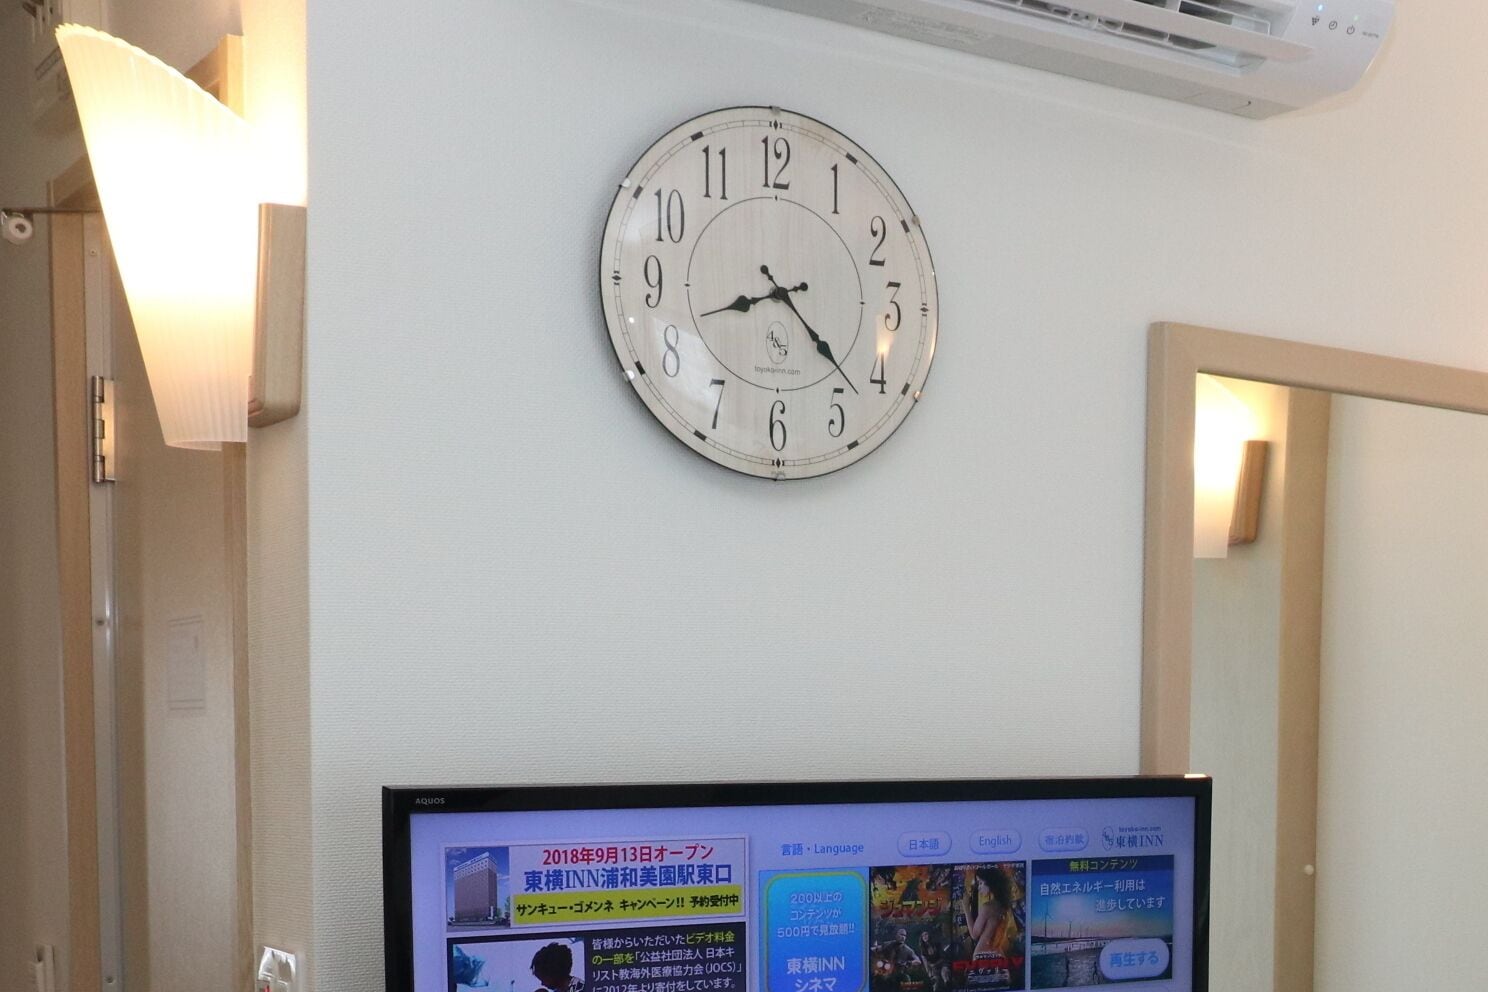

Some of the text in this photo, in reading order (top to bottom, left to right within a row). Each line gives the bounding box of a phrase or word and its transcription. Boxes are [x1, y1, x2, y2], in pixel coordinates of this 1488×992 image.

[702, 145, 728, 200] 11
[762, 136, 790, 190] 12
[830, 163, 840, 214] 1
[654, 188, 685, 243] 10
[869, 216, 886, 266] 2
[643, 255, 663, 308] 9
[884, 281, 901, 331] 3
[662, 325, 680, 377] 8
[869, 347, 887, 394] 4
[709, 379, 725, 429] 7
[828, 387, 845, 437] 5
[769, 400, 787, 451] 6
[415, 797, 445, 805] AQUOS
[908, 838, 940, 851] 日本語
[978, 834, 1012, 848] English
[1115, 832, 1164, 848] 東横INN
[543, 843, 713, 866] 2018年9月13日オープン
[1069, 857, 1138, 872] 無料コンテンツ
[524, 864, 732, 892] 東横INN浦和美園駅東口
[1039, 879, 1146, 896] 自然エネルギー利用は
[516, 901, 614, 917] サンキュー・ゴメンネ
[689, 894, 739, 909] 予約受付中
[789, 908, 841, 921] コンテンツが
[1095, 895, 1167, 913] 進歩しています
[592, 931, 735, 950] 皆様からいただいたビデオ料金
[787, 956, 845, 974] 東横INN
[1110, 949, 1160, 968] 再生する
